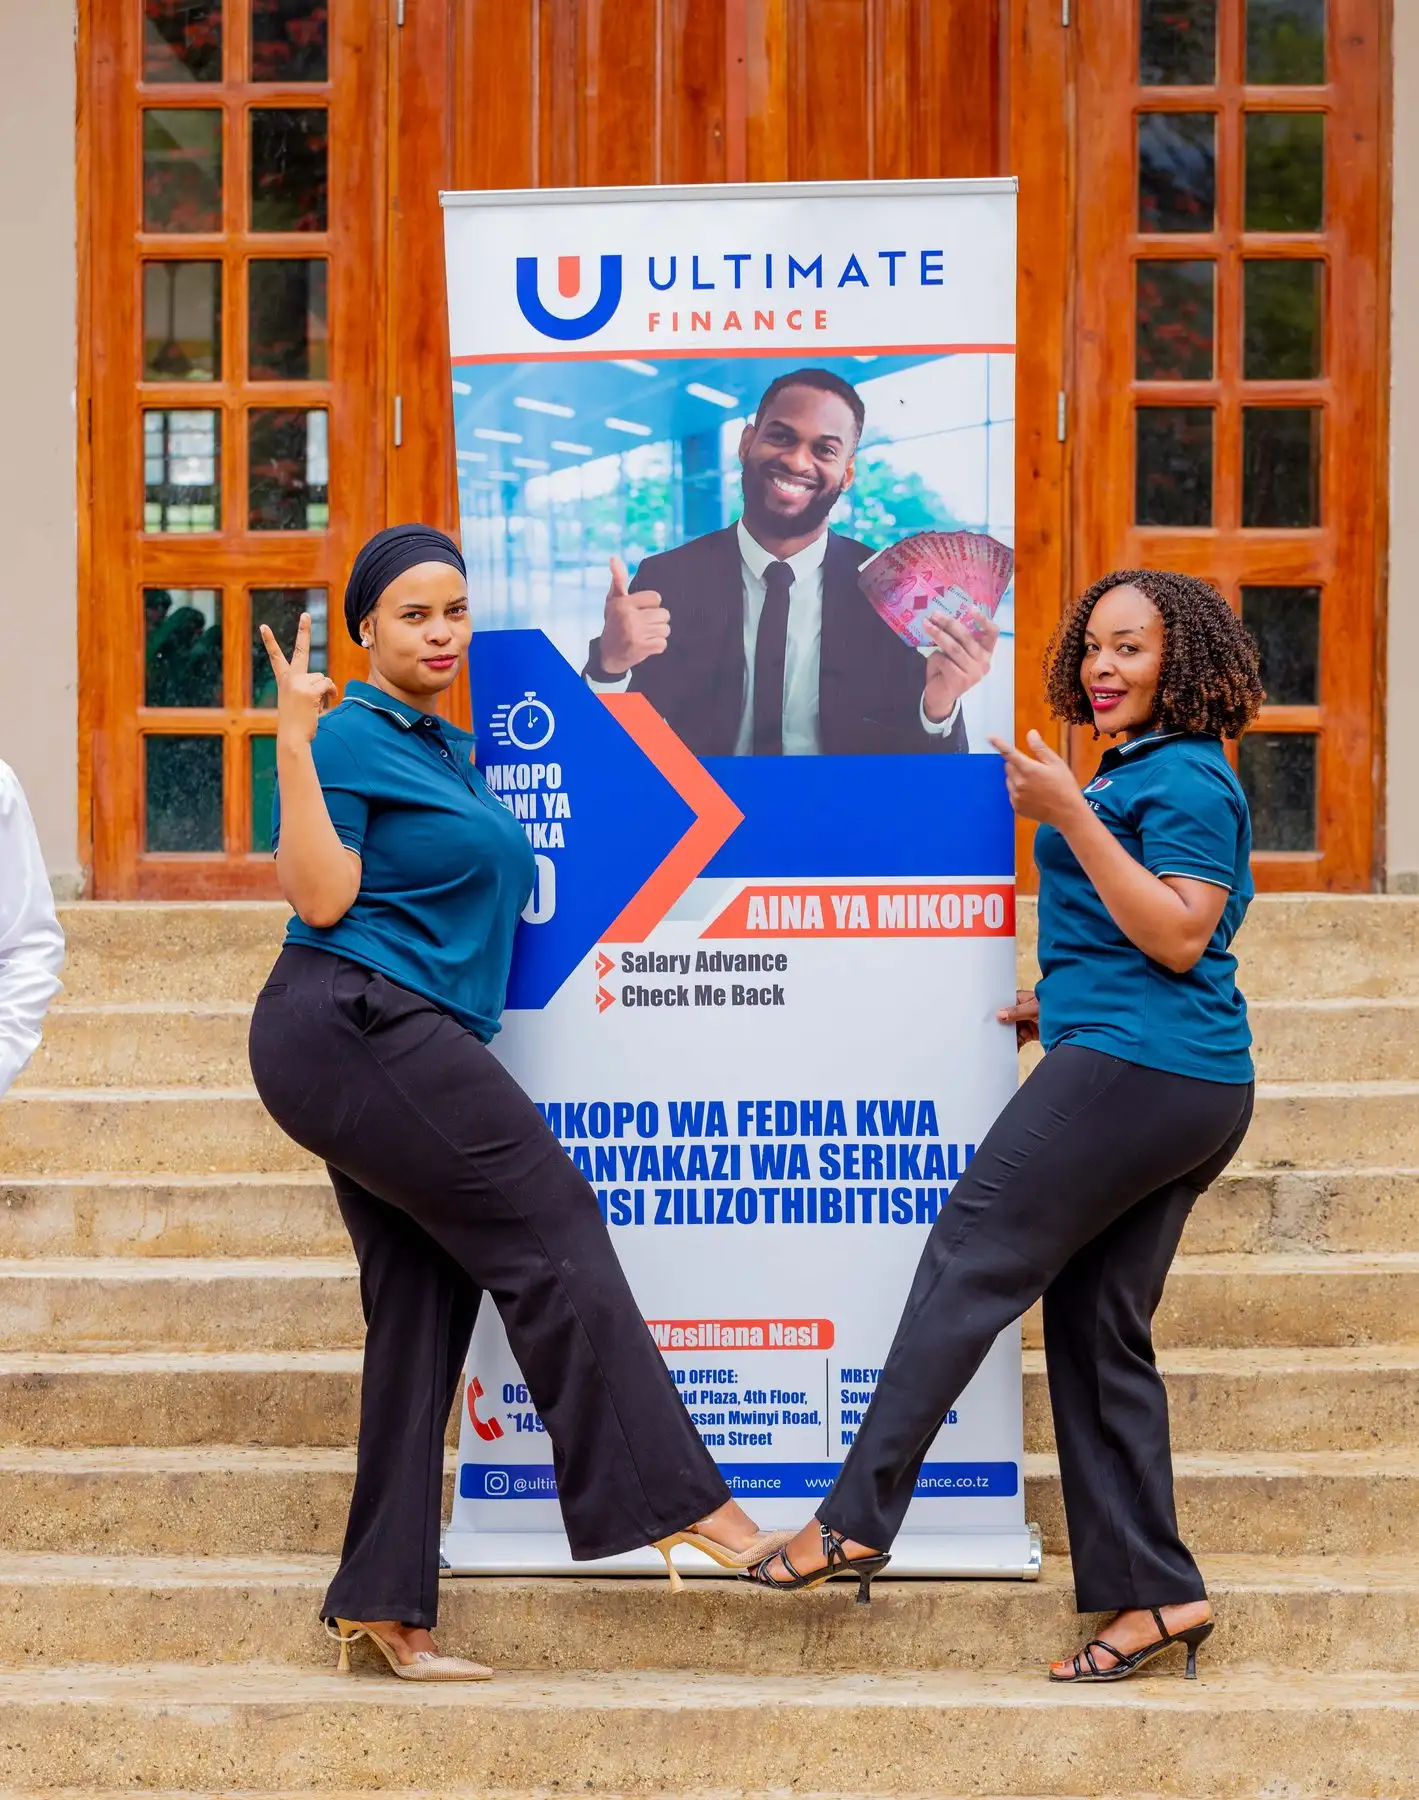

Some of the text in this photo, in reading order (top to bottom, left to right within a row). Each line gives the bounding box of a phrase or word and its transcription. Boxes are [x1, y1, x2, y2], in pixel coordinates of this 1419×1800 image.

[649, 250, 943, 290] ULTIMATE
[648, 309, 827, 332] FINANCE
[485, 763, 562, 791] MKOPO
[502, 793, 571, 819] ANI YA
[746, 893, 1004, 930] AINA YA MIKOPO
[621, 950, 788, 975] Salary Advance
[621, 984, 785, 1007] Check Me Back
[534, 1100, 939, 1138] MKOPO WA FEDHA KWA
[564, 1145, 740, 1182] ANYAKAZI
[750, 1144, 810, 1180] WA
[648, 1323, 819, 1347] Wasiliana Nasi
[689, 1369, 738, 1384] OFFICE:
[700, 1390, 741, 1406] Plaza,
[743, 1390, 767, 1405] 4th
[770, 1389, 808, 1405] Floor,
[728, 1410, 779, 1427] Mwinyi
[782, 1410, 821, 1426] Road,
[728, 1431, 773, 1446] Street
